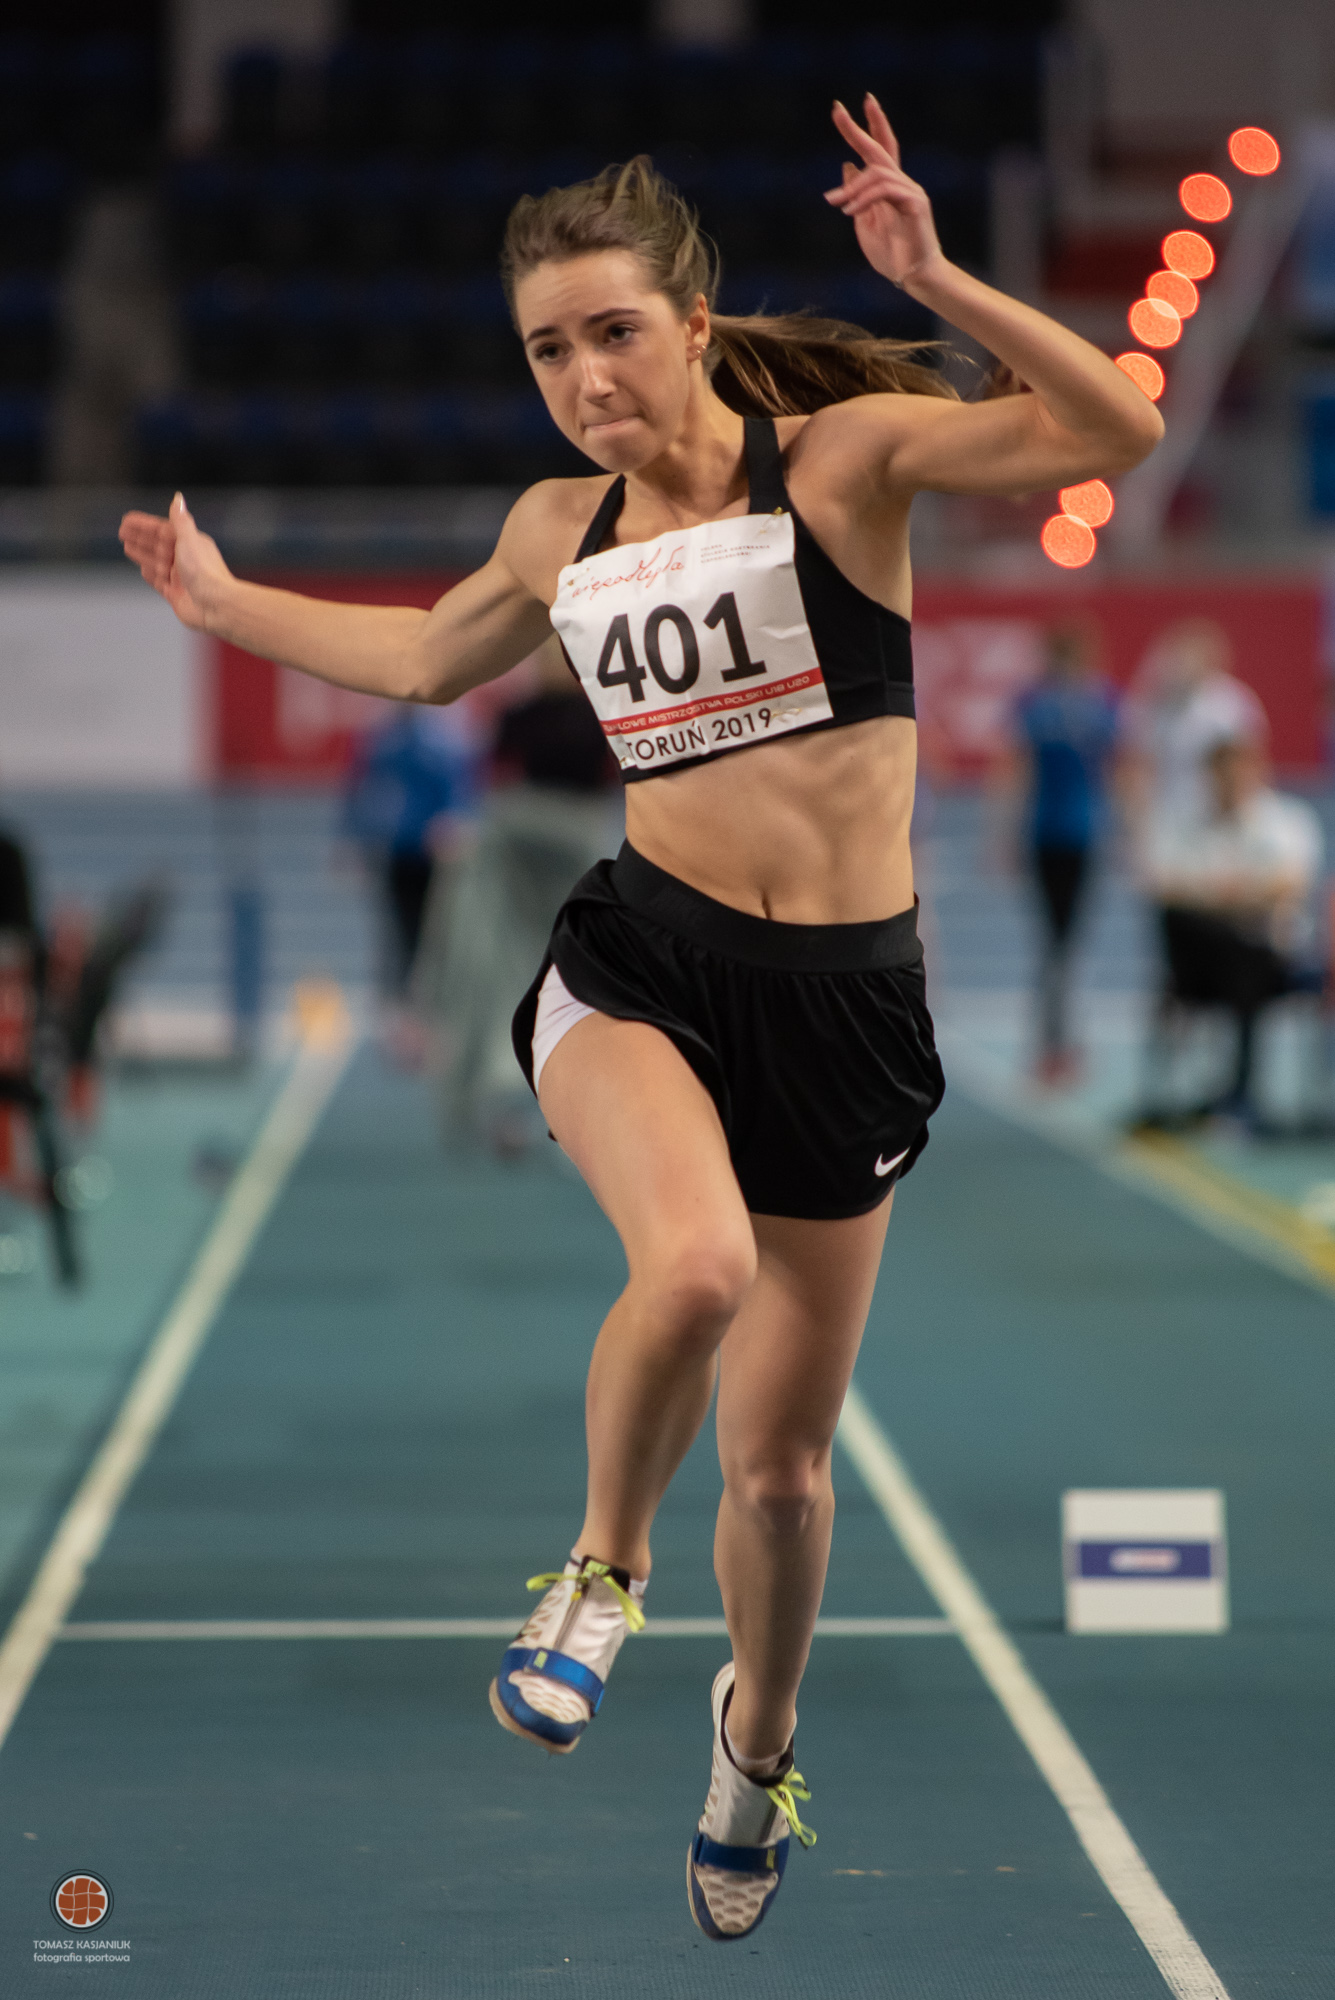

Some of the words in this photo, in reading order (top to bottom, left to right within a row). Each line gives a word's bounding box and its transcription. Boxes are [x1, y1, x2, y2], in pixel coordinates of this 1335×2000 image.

[597, 591, 767, 704] 401
[648, 699, 723, 724] MISTRZOSTWA
[724, 690, 764, 705] POLSKI
[765, 683, 785, 695] U18
[787, 675, 810, 689] U20
[711, 707, 771, 742] 2019
